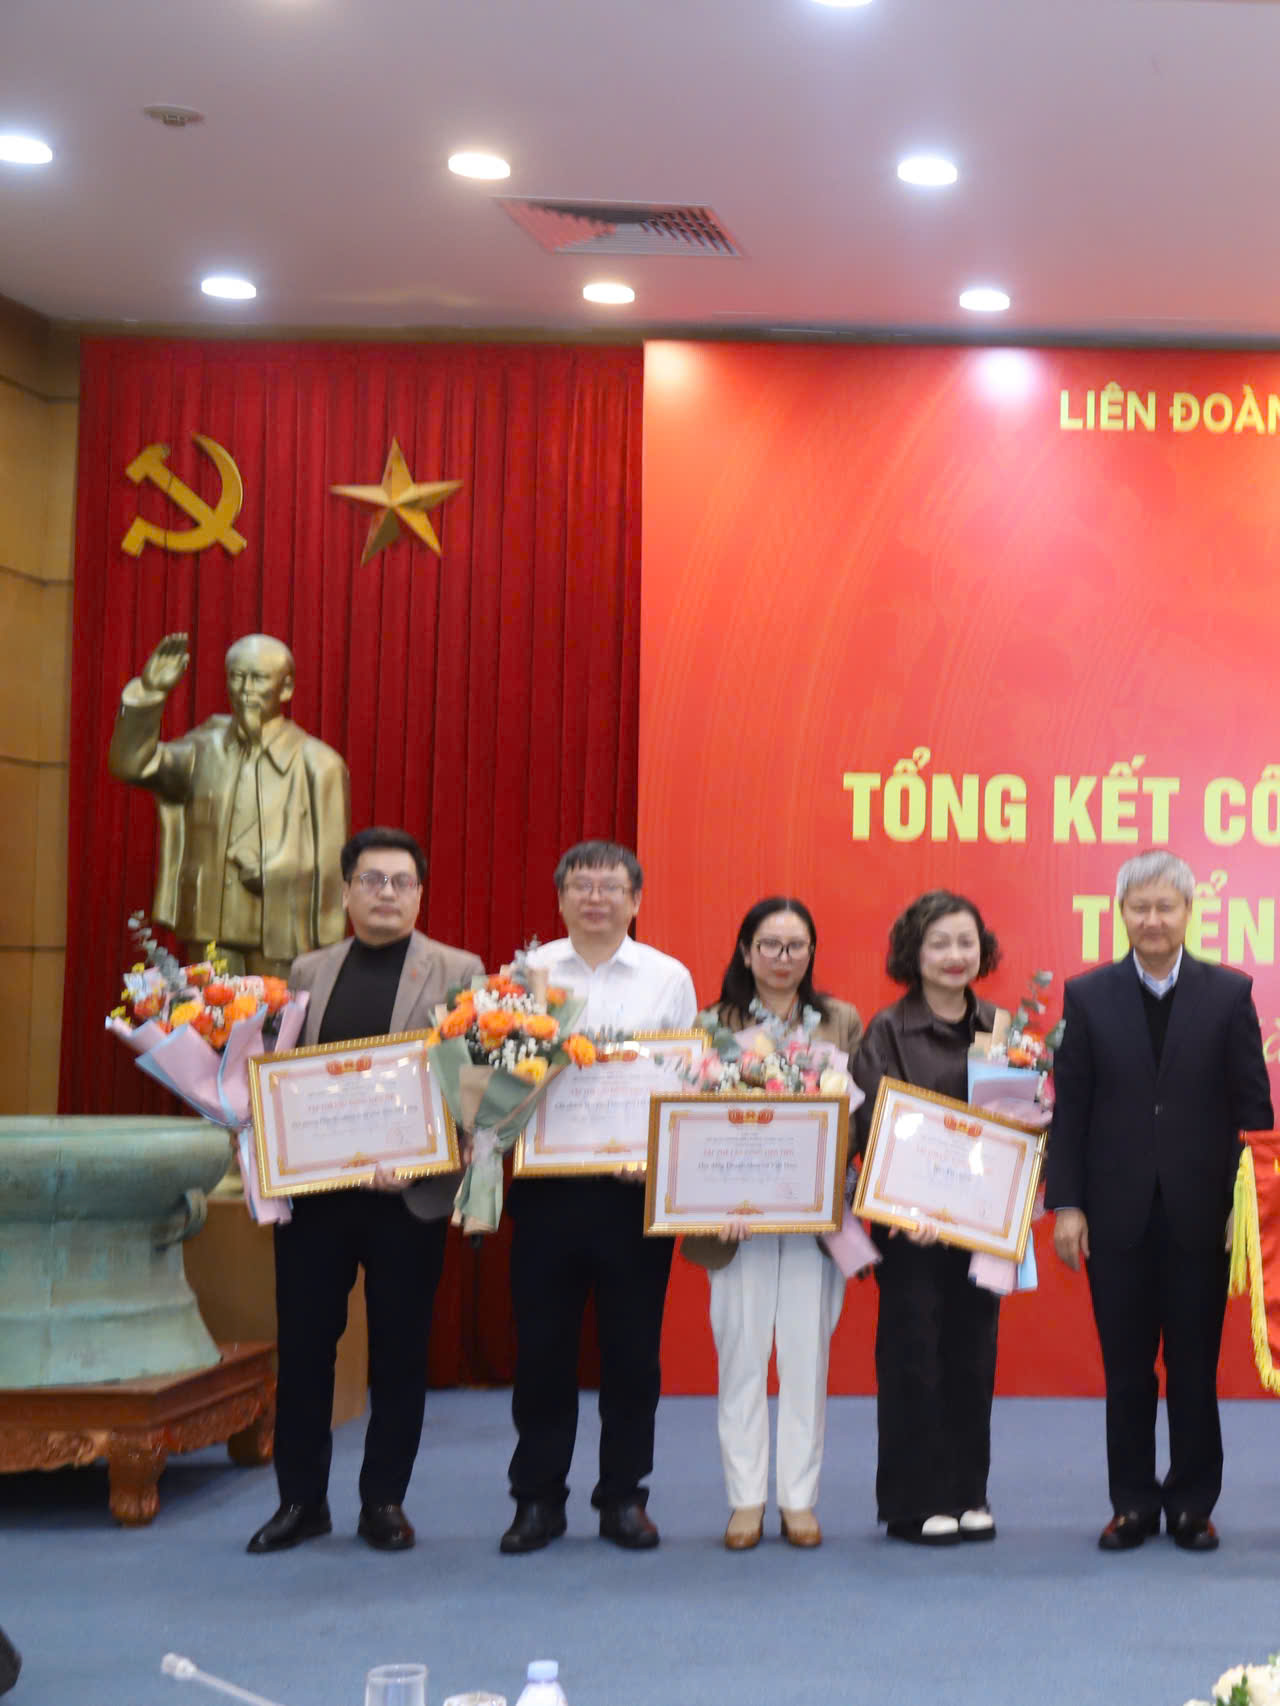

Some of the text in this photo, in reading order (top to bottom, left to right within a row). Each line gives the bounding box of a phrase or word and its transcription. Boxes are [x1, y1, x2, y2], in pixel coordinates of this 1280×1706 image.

[1060, 381, 1156, 431] LIÊN
[843, 746, 1027, 843] TỔNG
[1052, 755, 1180, 844] KẾT
